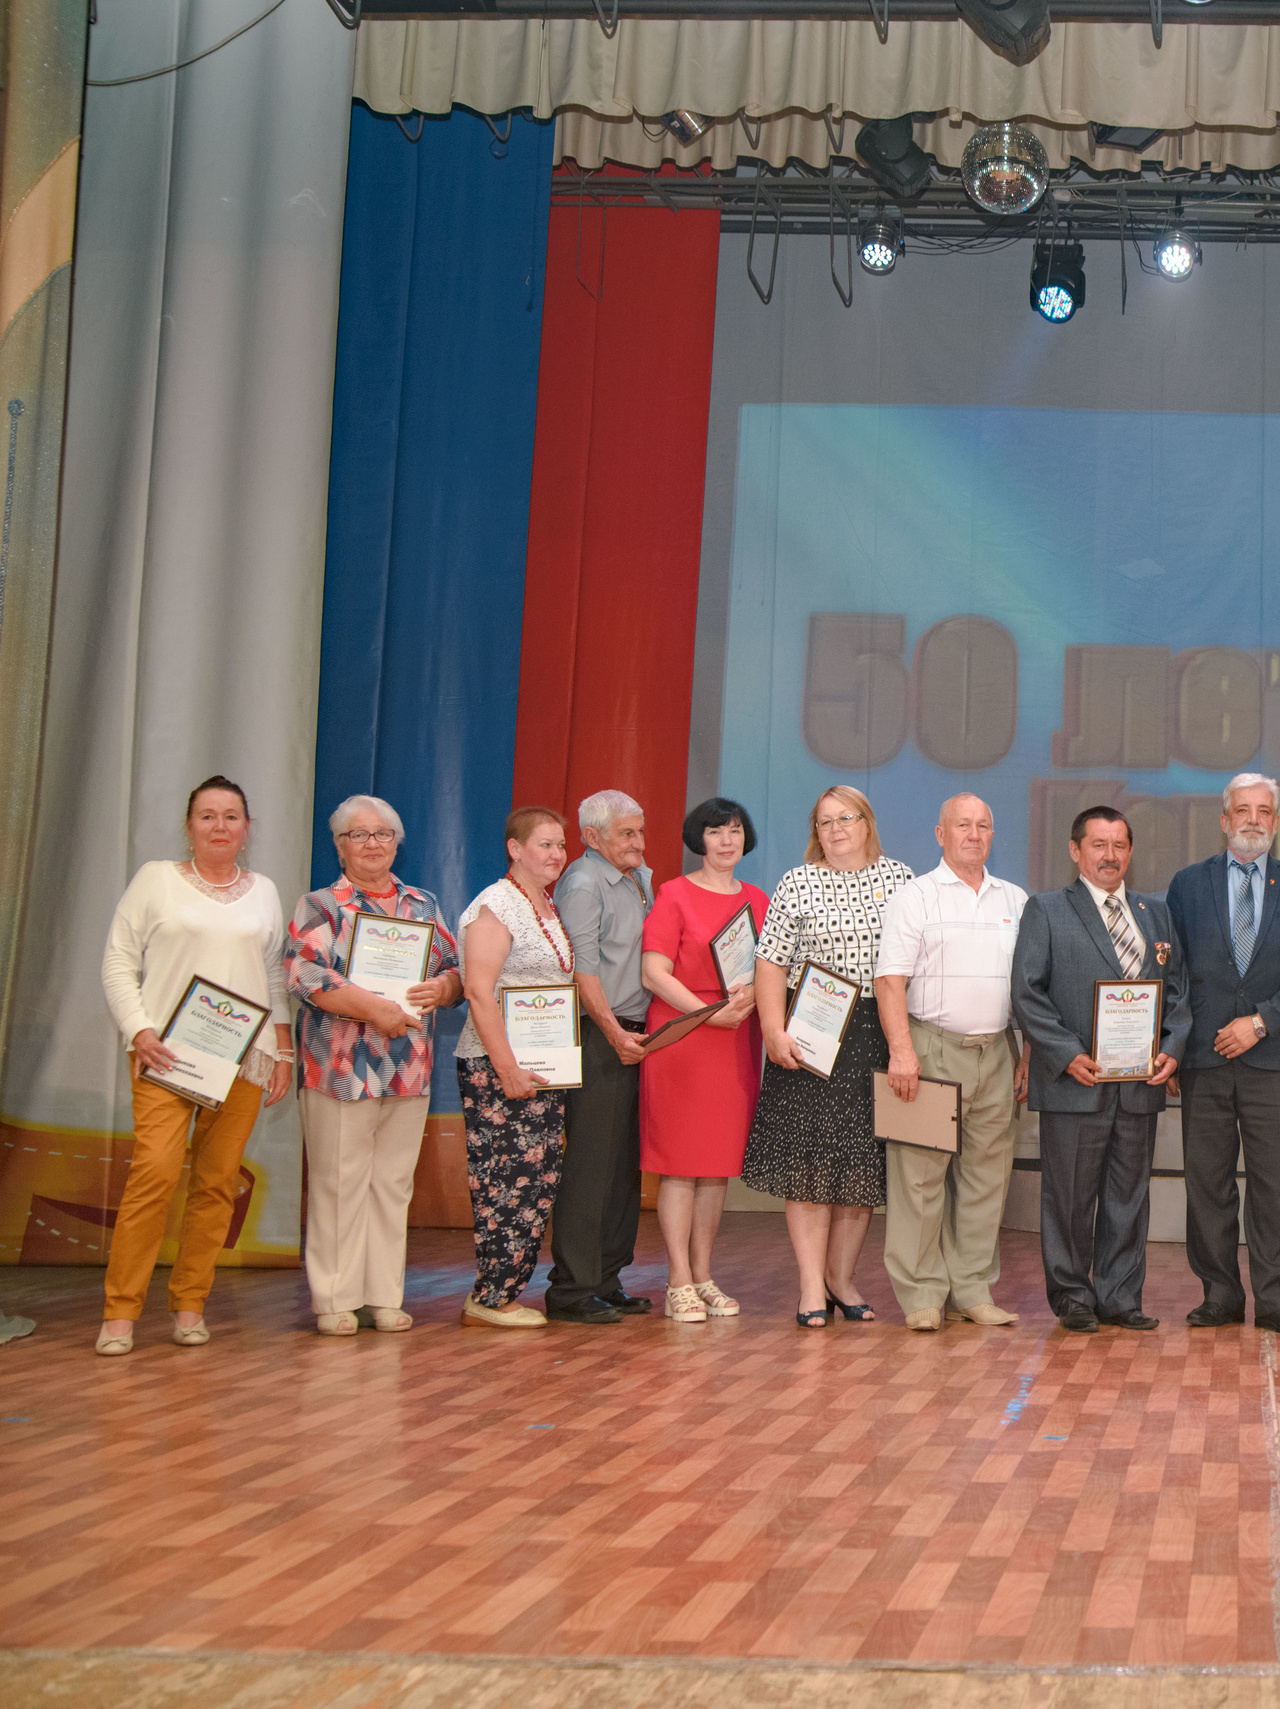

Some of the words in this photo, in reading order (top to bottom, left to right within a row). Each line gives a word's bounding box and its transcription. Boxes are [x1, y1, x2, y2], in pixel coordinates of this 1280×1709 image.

[802, 613, 1018, 771] 50
[190, 1010, 242, 1038] БЛАГОДАРНОСТЬ
[514, 1013, 566, 1022] БЛАГОДАРНОСТЬ
